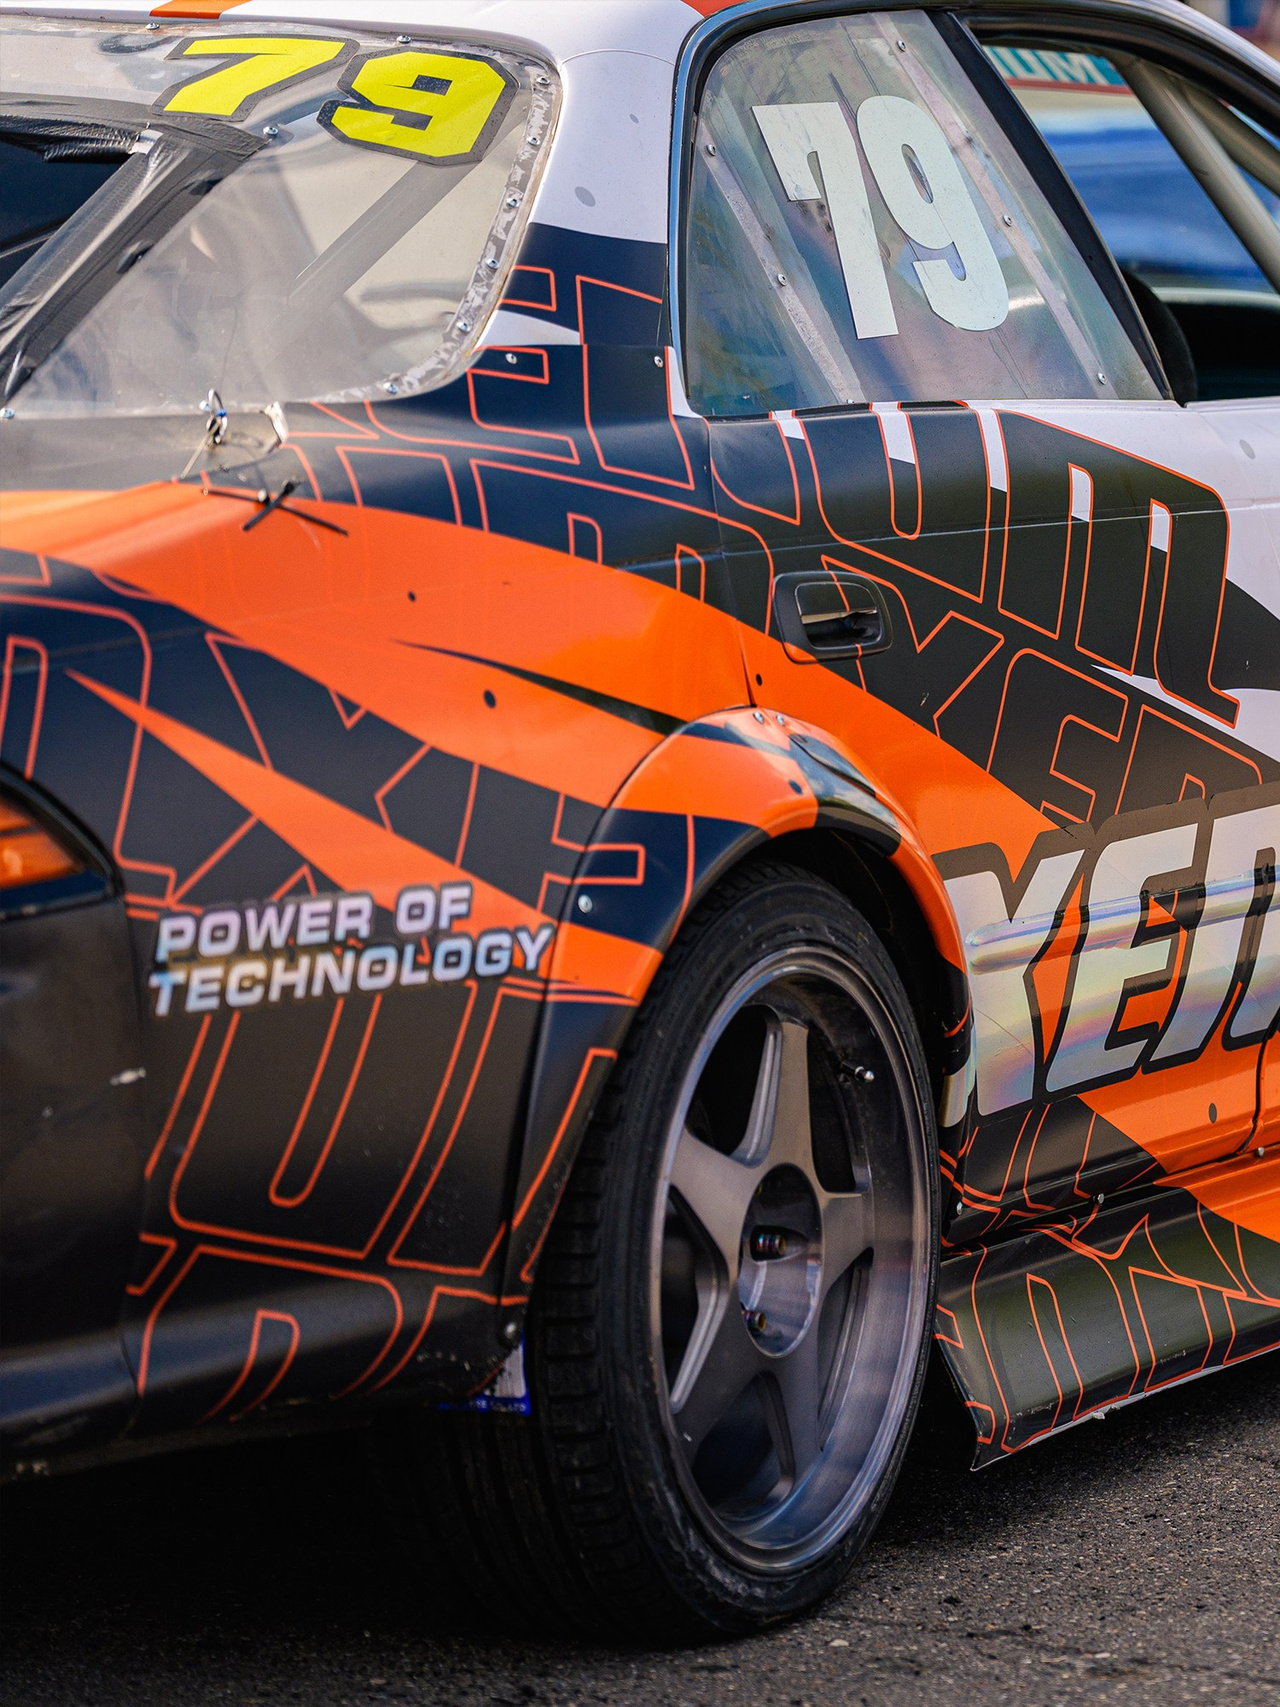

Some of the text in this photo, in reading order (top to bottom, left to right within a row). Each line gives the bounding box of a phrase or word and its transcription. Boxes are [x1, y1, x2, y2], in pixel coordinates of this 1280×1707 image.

[160, 36, 508, 159] 79
[752, 95, 1009, 340] 79
[148, 923, 556, 1018] TECHNOLOGY
[155, 883, 473, 964] POWER OF
